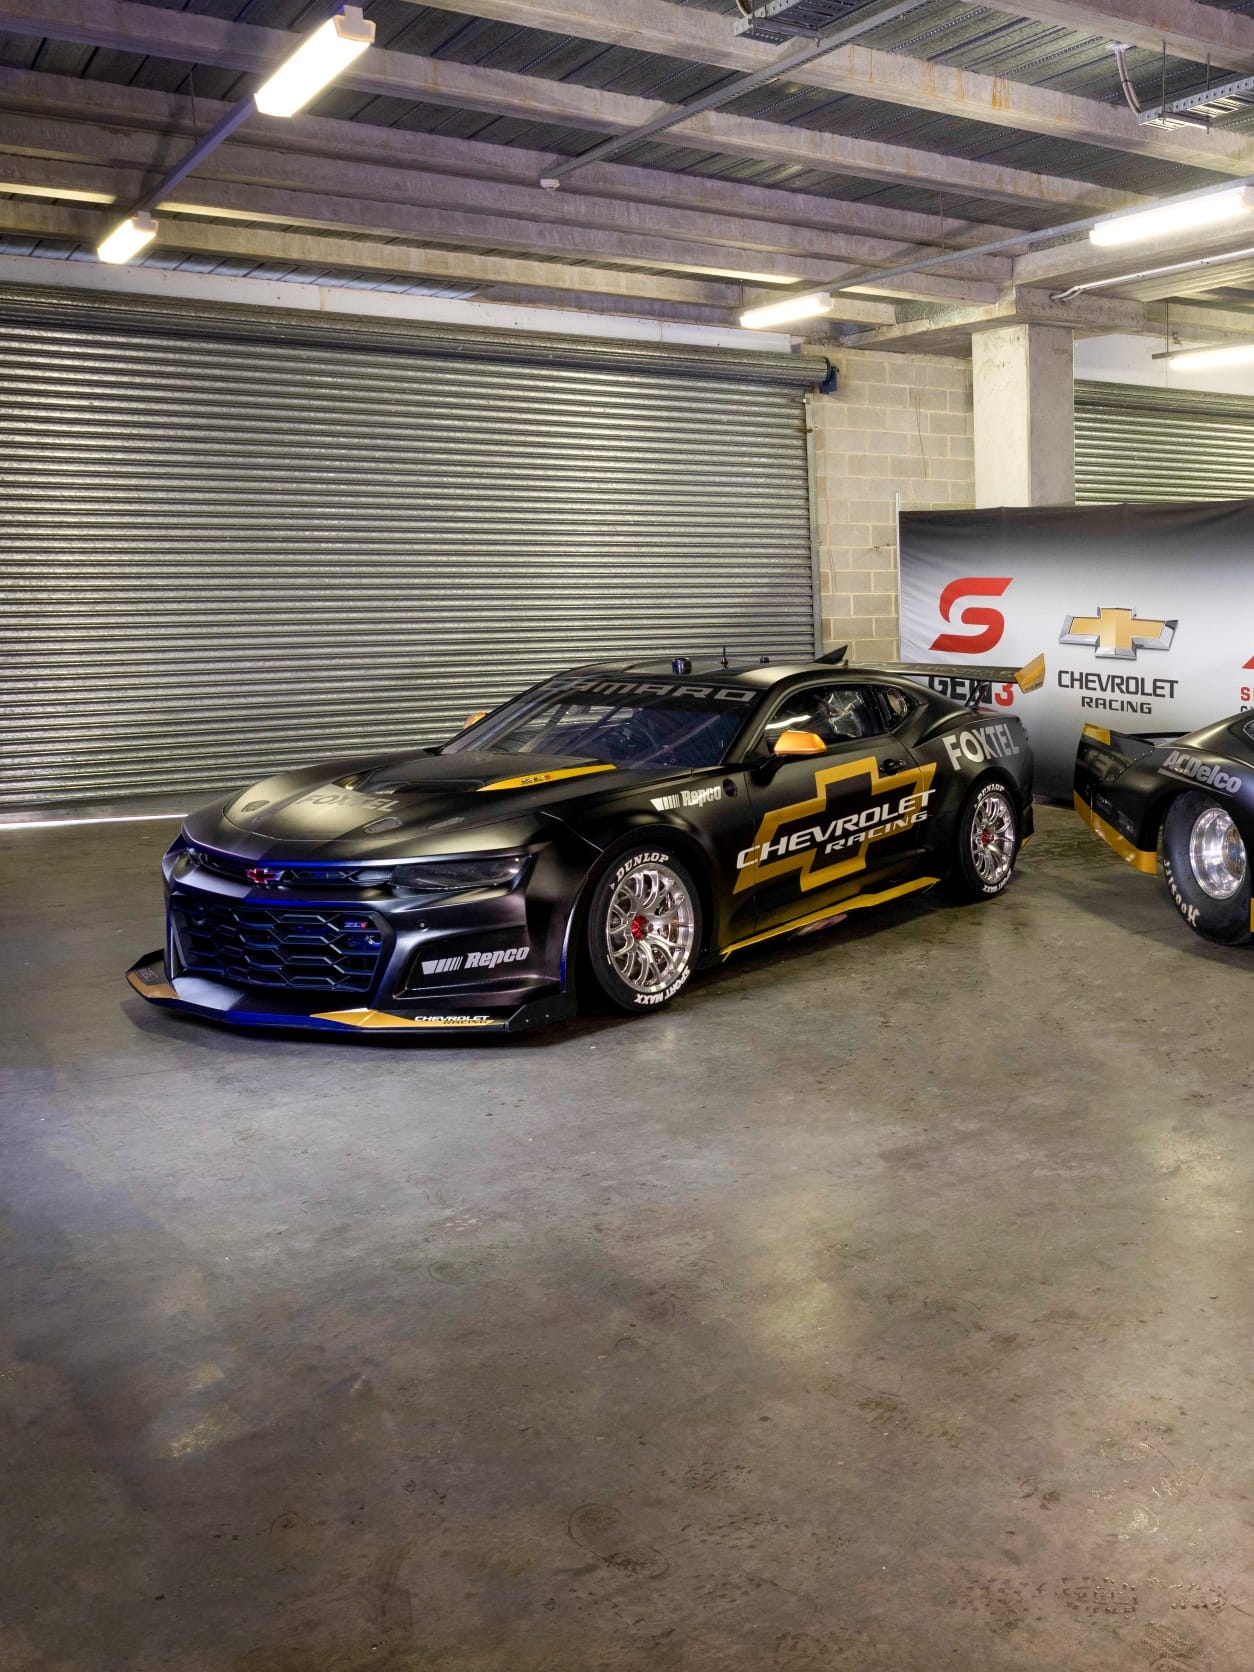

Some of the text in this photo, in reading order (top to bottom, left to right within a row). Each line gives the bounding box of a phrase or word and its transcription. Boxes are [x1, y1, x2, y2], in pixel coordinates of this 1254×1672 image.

[538, 680, 757, 702] CAMARO
[1057, 670, 1179, 698] CHEVROLET
[1081, 696, 1152, 714] RACING
[942, 723, 1020, 771] FOXTEL
[1162, 750, 1243, 794] ACDelco
[680, 786, 722, 807] Repco
[736, 789, 936, 869] CHEVROLET
[825, 811, 928, 854] RACING
[616, 852, 670, 882] DUNLOP
[464, 946, 530, 969] Repco
[633, 965, 692, 1005] SPORT MAXX
